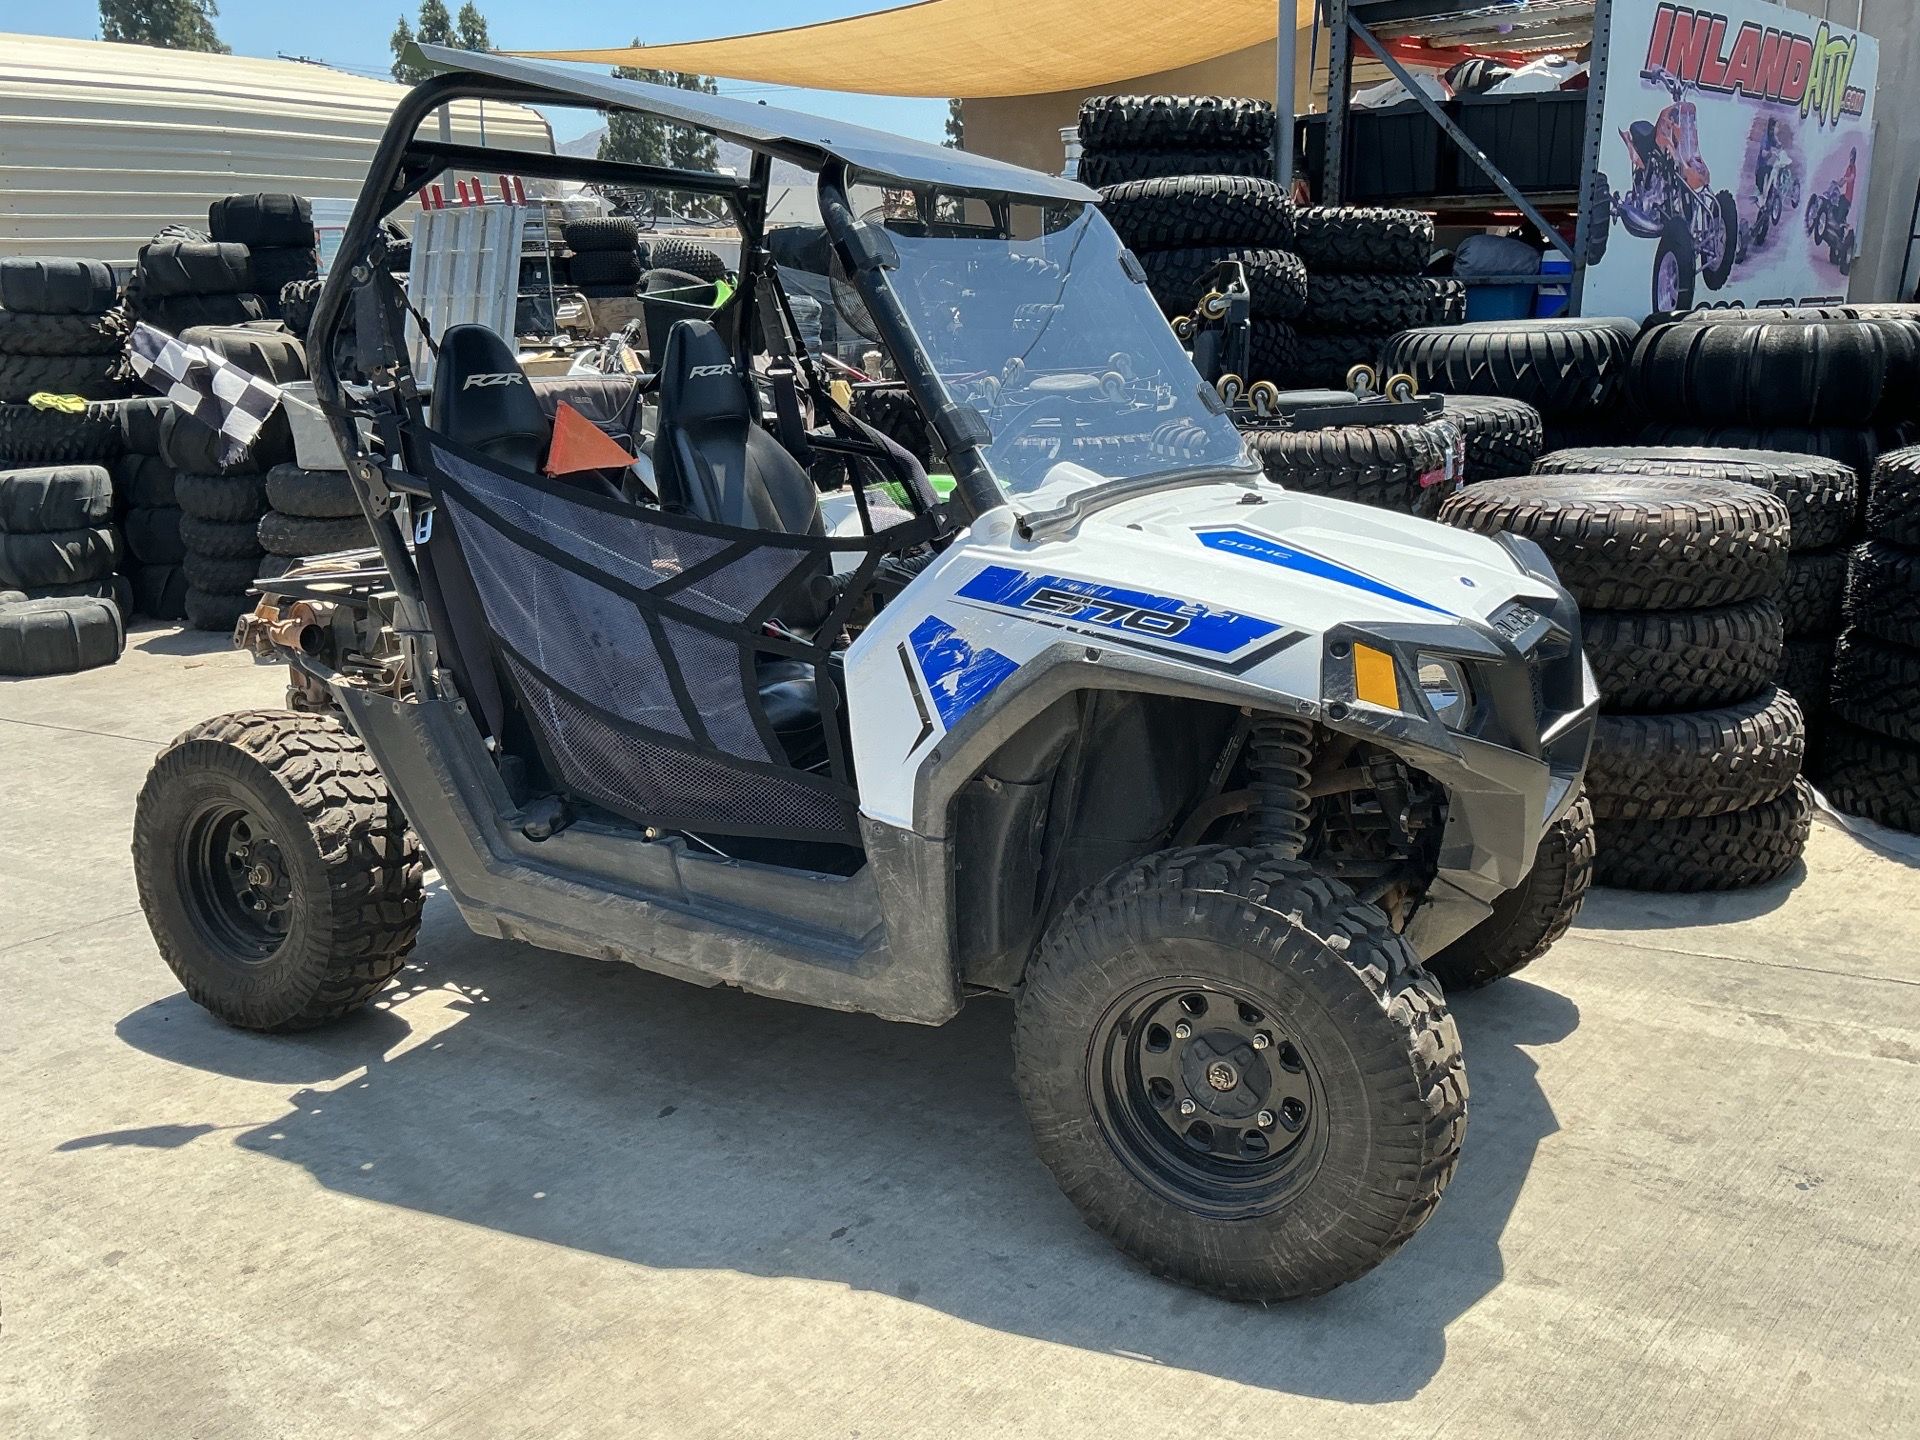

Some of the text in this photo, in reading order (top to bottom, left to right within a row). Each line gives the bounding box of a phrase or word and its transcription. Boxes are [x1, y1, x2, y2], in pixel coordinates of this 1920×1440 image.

[688, 364, 733, 380] RZR
[463, 373, 524, 391] RZR
[1217, 539, 1293, 559] DOHC
[1021, 587, 1191, 637] 570
[1175, 605, 1239, 624] EFI
